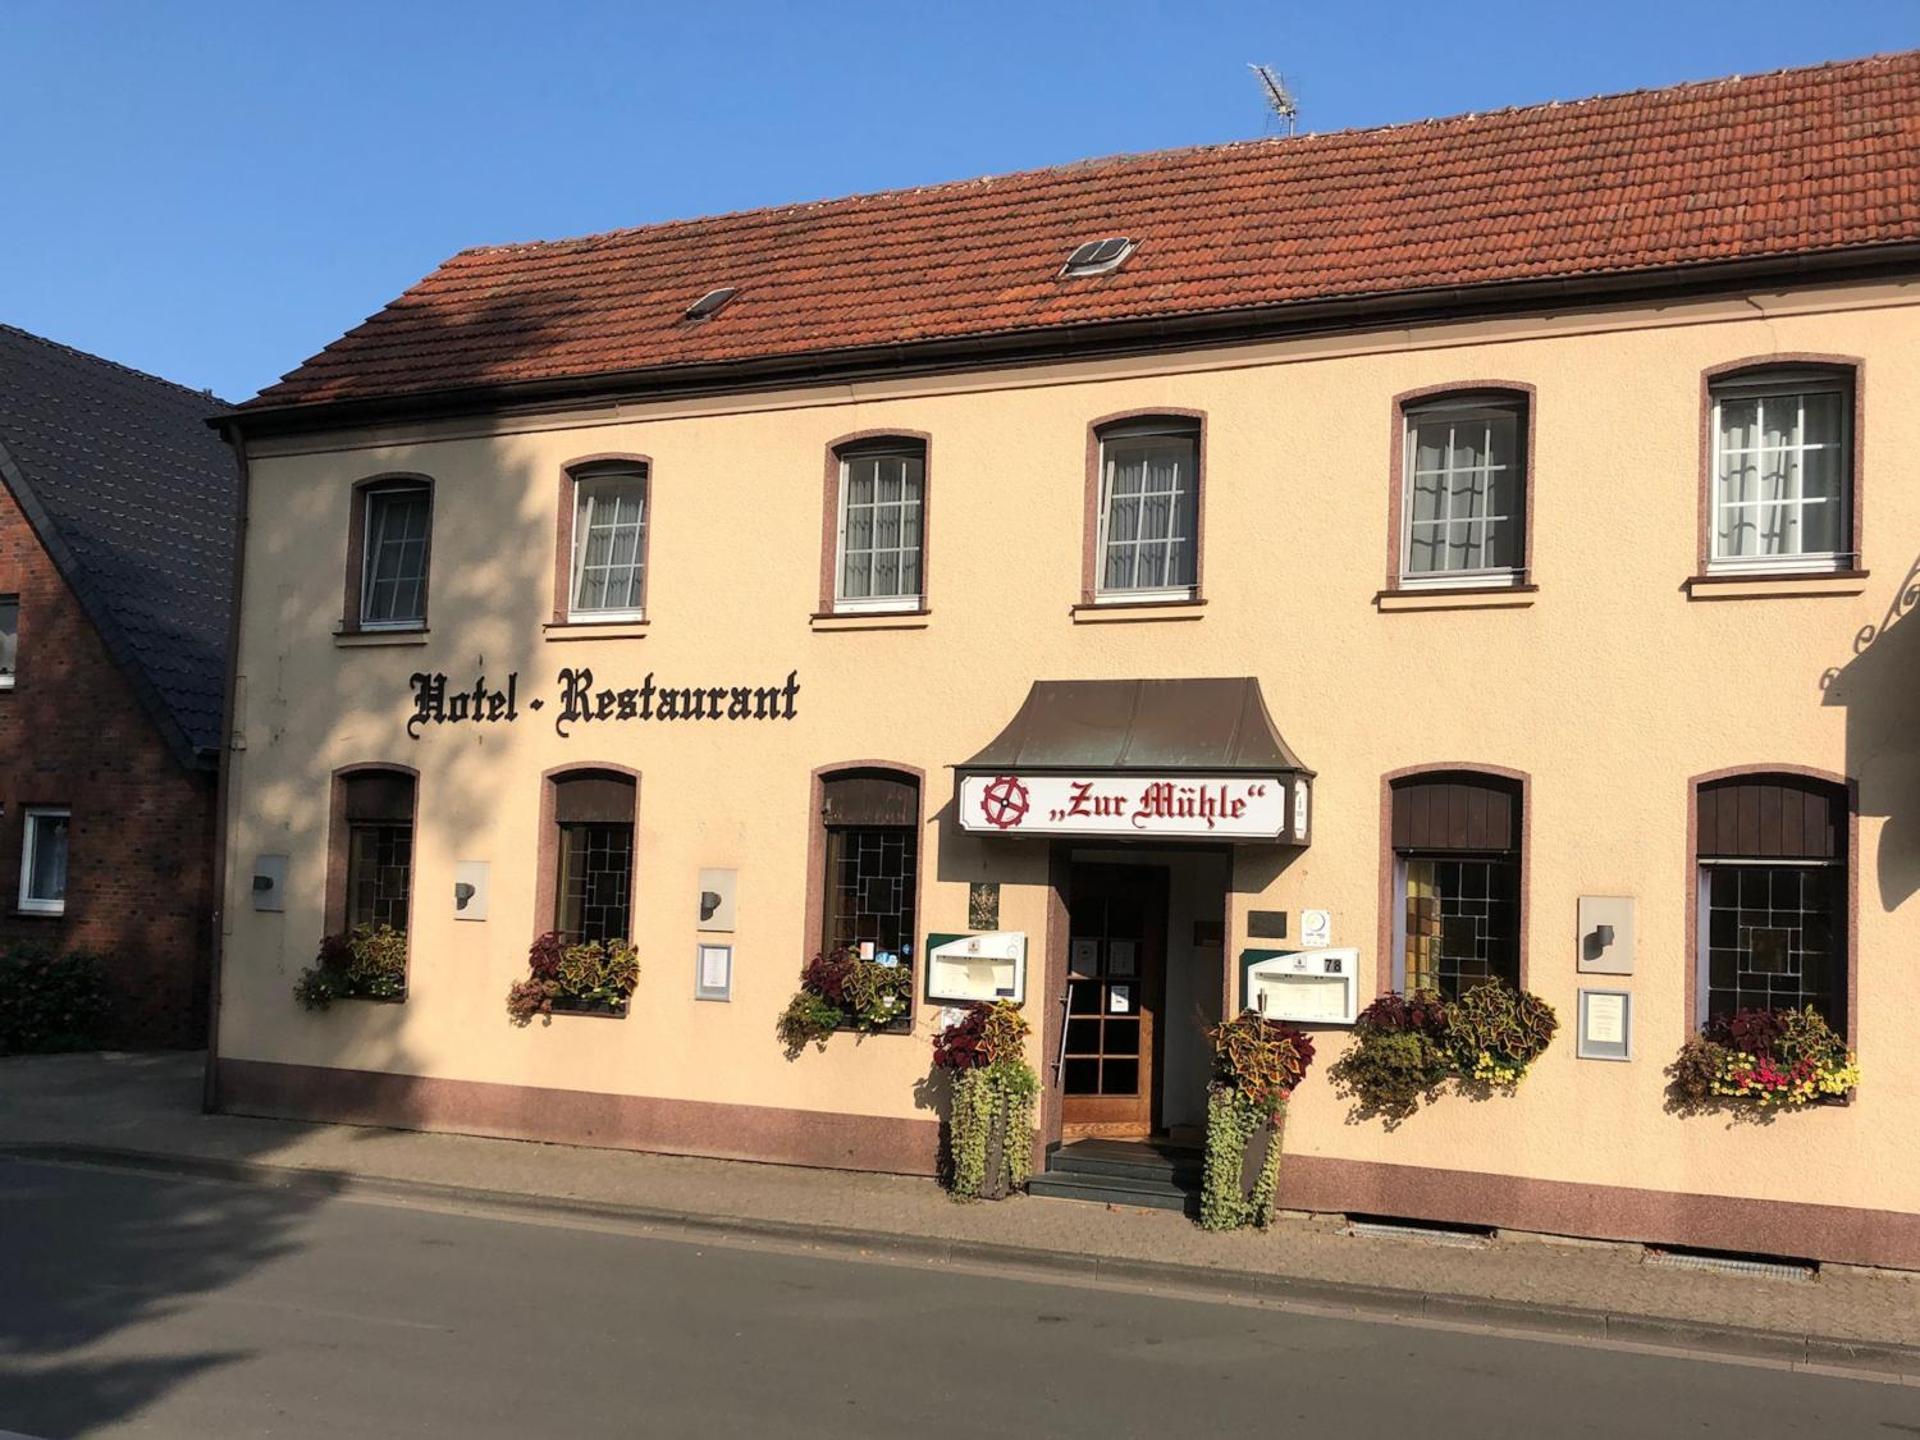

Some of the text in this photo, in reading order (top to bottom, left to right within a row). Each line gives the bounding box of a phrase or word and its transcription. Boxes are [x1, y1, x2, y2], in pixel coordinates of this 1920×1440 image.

[407, 671, 518, 740] Hotel
[556, 667, 800, 738] Restaurant
[1325, 959, 1341, 972] 78
